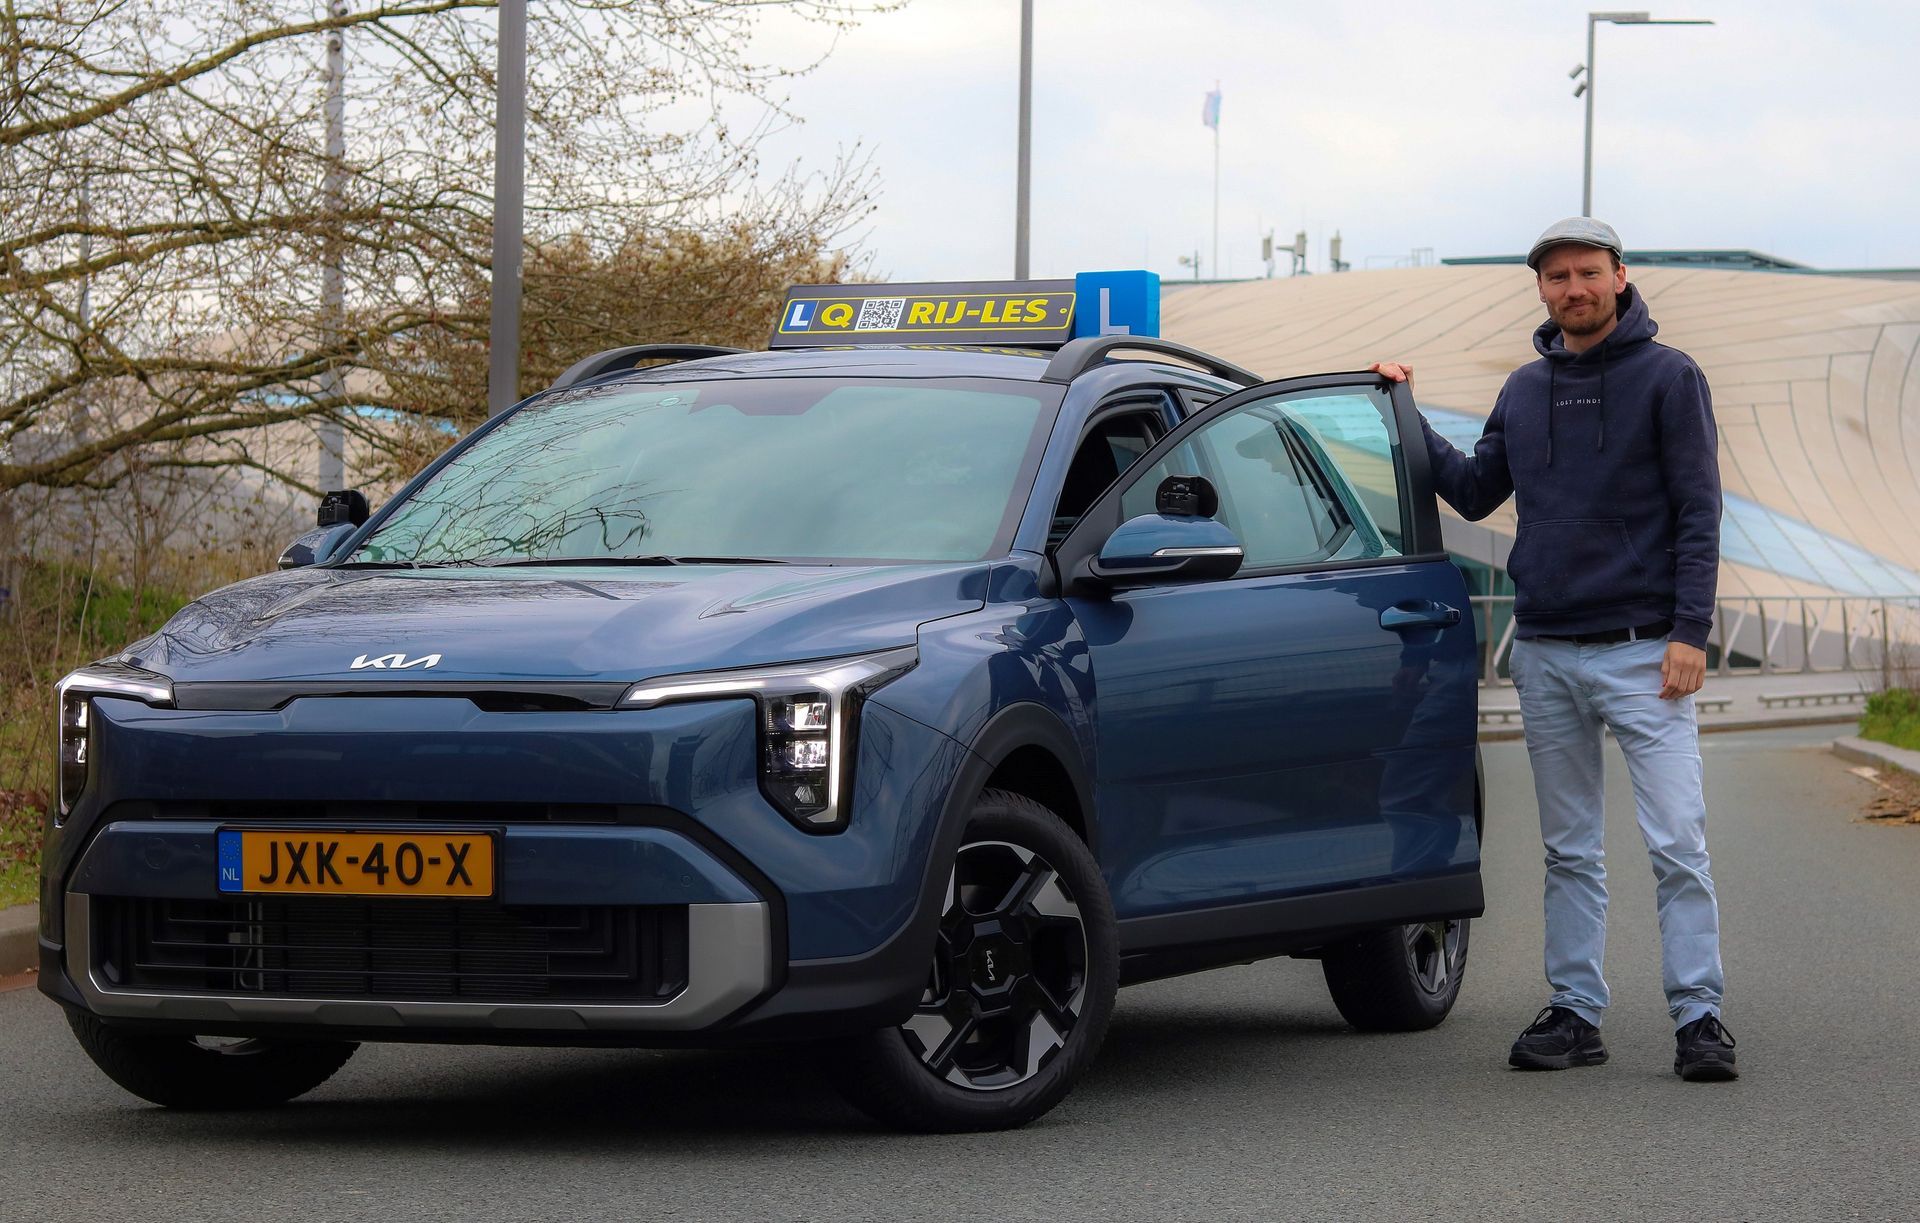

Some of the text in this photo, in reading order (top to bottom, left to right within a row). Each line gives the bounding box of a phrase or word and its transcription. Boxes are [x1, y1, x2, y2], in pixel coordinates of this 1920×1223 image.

[788, 298, 1050, 328] L Q RIJ-LES
[1099, 287, 1130, 336] L
[222, 867, 240, 881] NL
[258, 841, 473, 886] JXK-40-X
